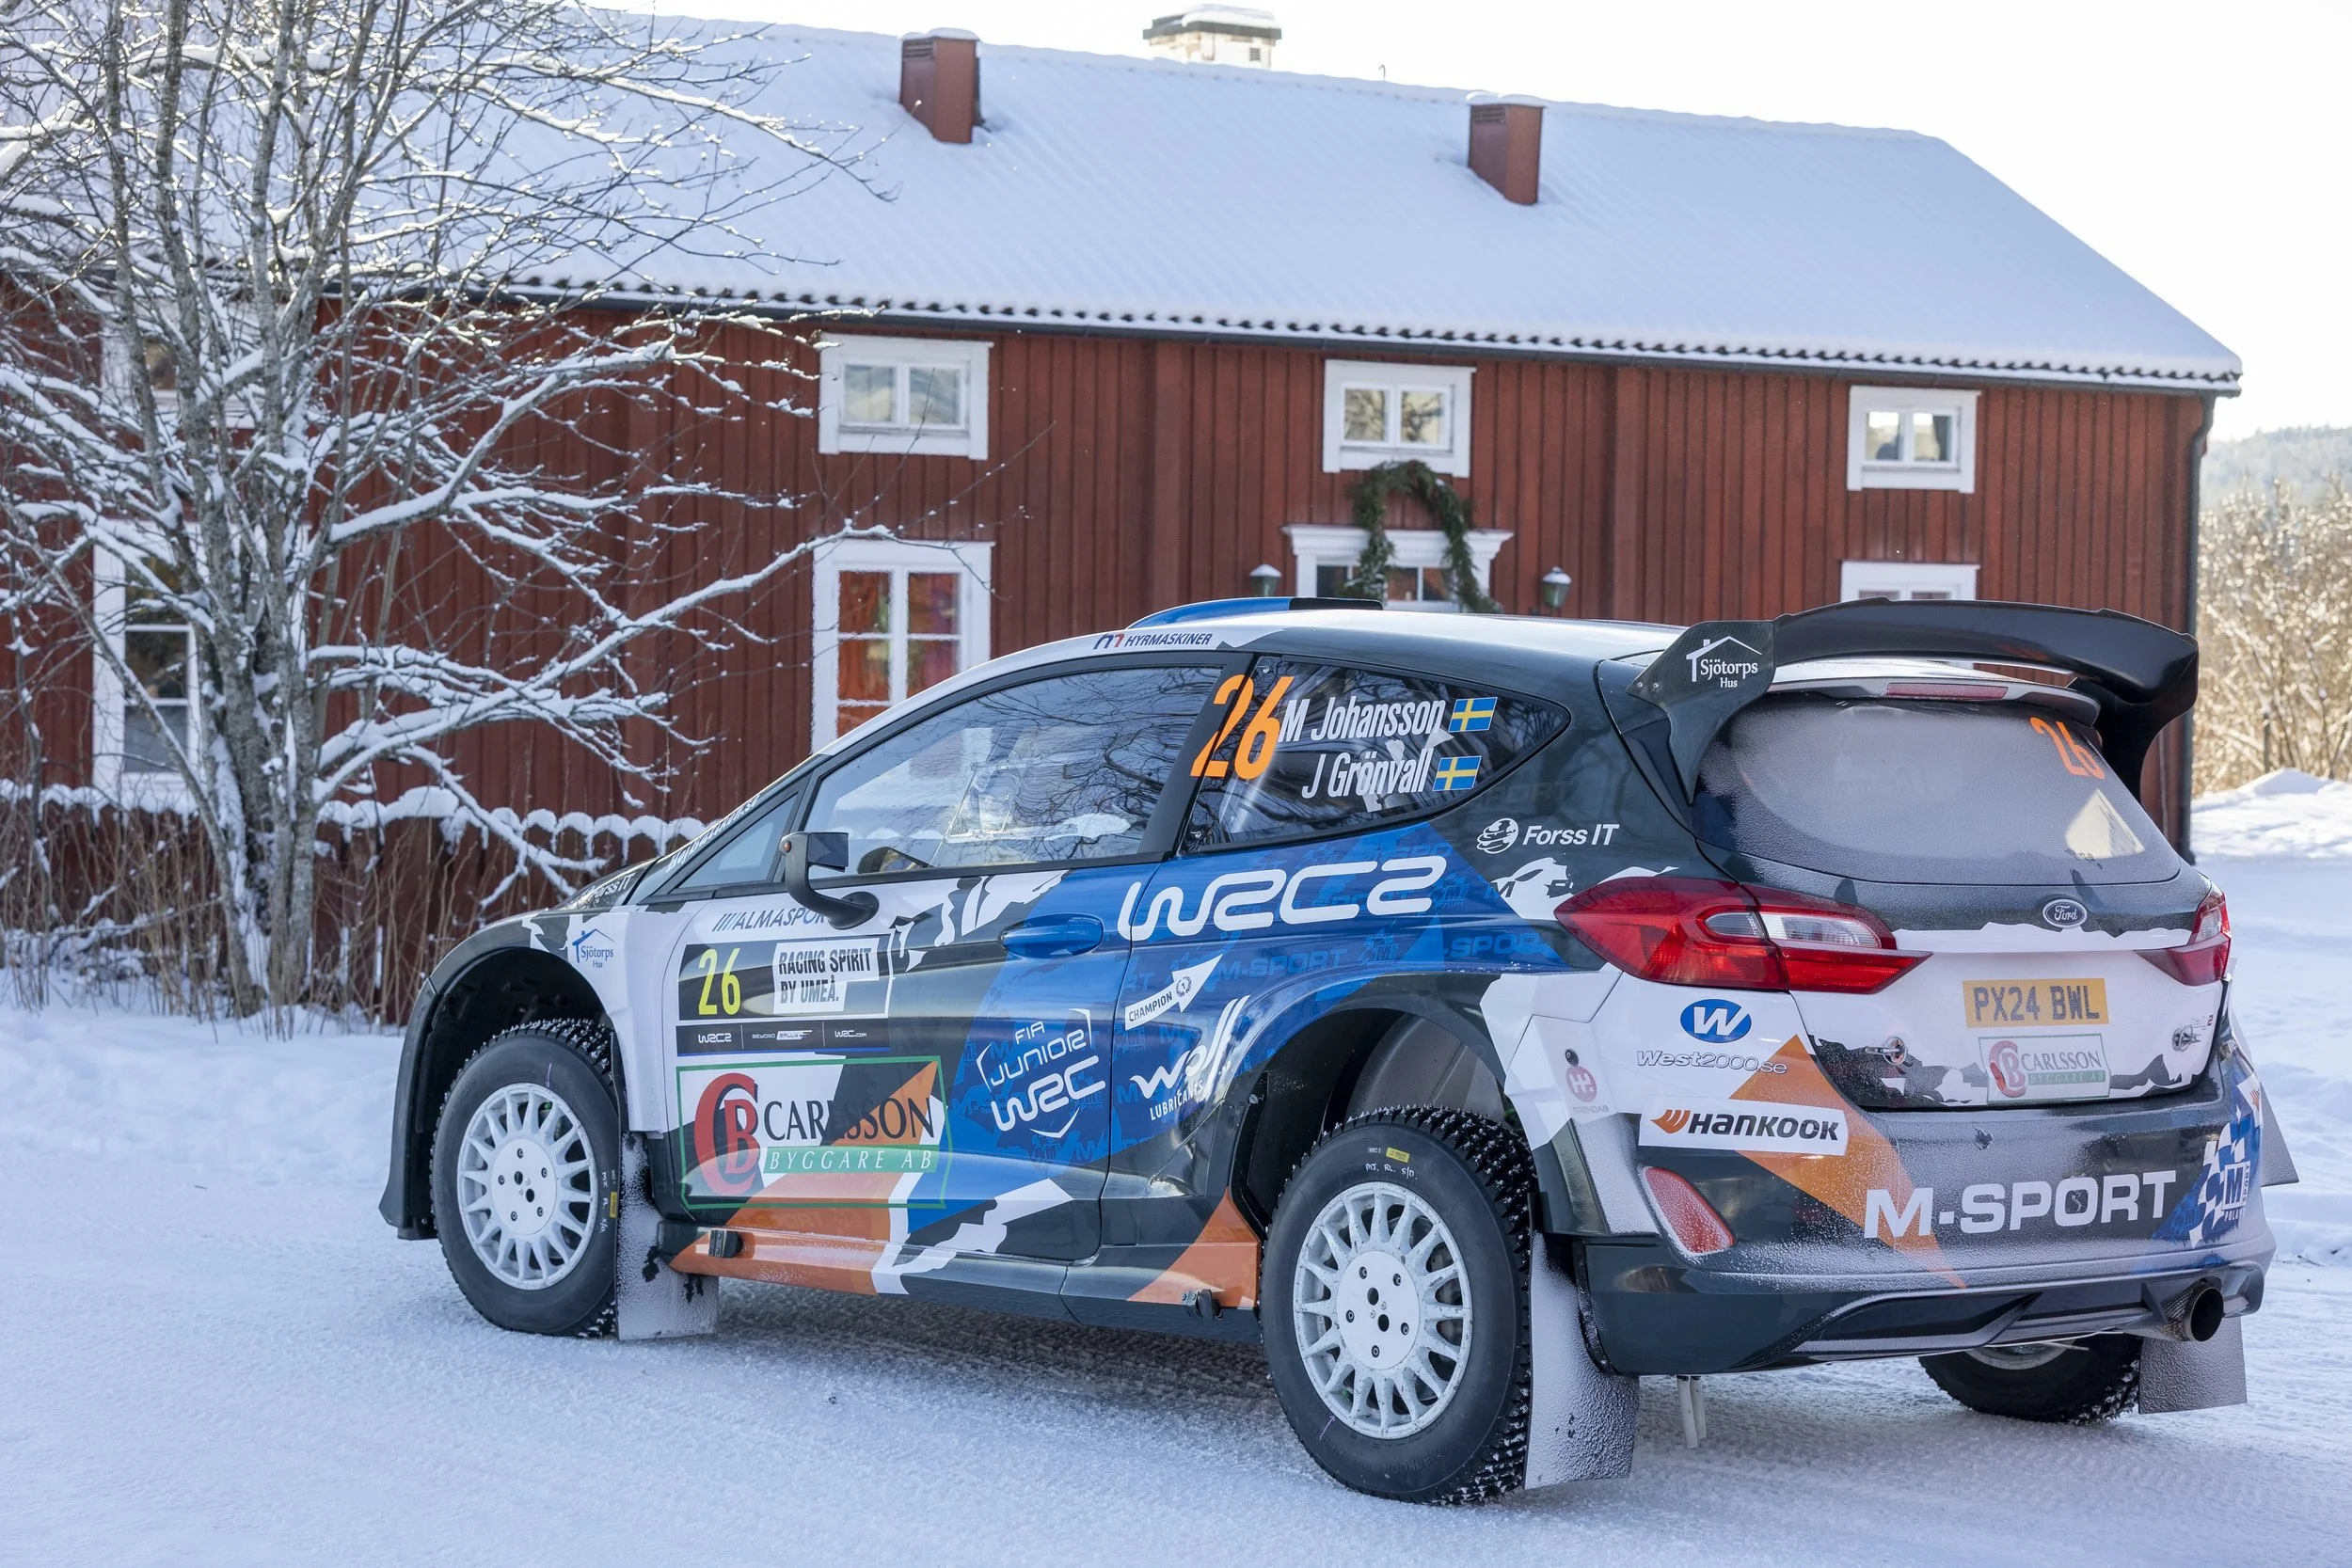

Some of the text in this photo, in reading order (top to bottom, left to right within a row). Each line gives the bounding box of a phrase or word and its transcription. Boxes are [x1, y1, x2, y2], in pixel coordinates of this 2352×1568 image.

[1124, 633, 1214, 647] HYRMASKINER
[1700, 658, 1758, 681] Sjötorps
[1720, 677, 1739, 689] Hus
[1190, 673, 1295, 780] 26
[1278, 695, 1447, 742] M Johansson
[2030, 717, 2106, 780] 26
[1302, 748, 1434, 800] J Grönvall
[1522, 824, 1620, 846] Forss IT
[1118, 855, 1447, 942] WRC2
[2054, 905, 2078, 922] Ford
[580, 945, 614, 961] Sjötorps
[593, 959, 603, 968] Hus
[779, 947, 872, 975] RACING SPIRIT
[698, 947, 741, 1016] 26
[780, 974, 840, 1005] BY UMEÅ.
[1129, 991, 1173, 1022] CHAMPION
[1973, 985, 2101, 1022] PX24 BWL
[698, 1032, 732, 1044] WRC2
[834, 1030, 867, 1038] WRC.com
[1015, 1021, 1045, 1045] FIA
[990, 1028, 1087, 1086] JUNIOR
[1636, 1050, 1788, 1074] West2000.se
[2021, 1050, 2103, 1071] CARLSSON
[2029, 1071, 2104, 1083] BYGGARE AB
[990, 1054, 1106, 1132] WRC
[1149, 1079, 1203, 1121] LUBRICANTS
[770, 1148, 932, 1170] BYGGARE AB
[1864, 1170, 2177, 1239] M-SPORT
